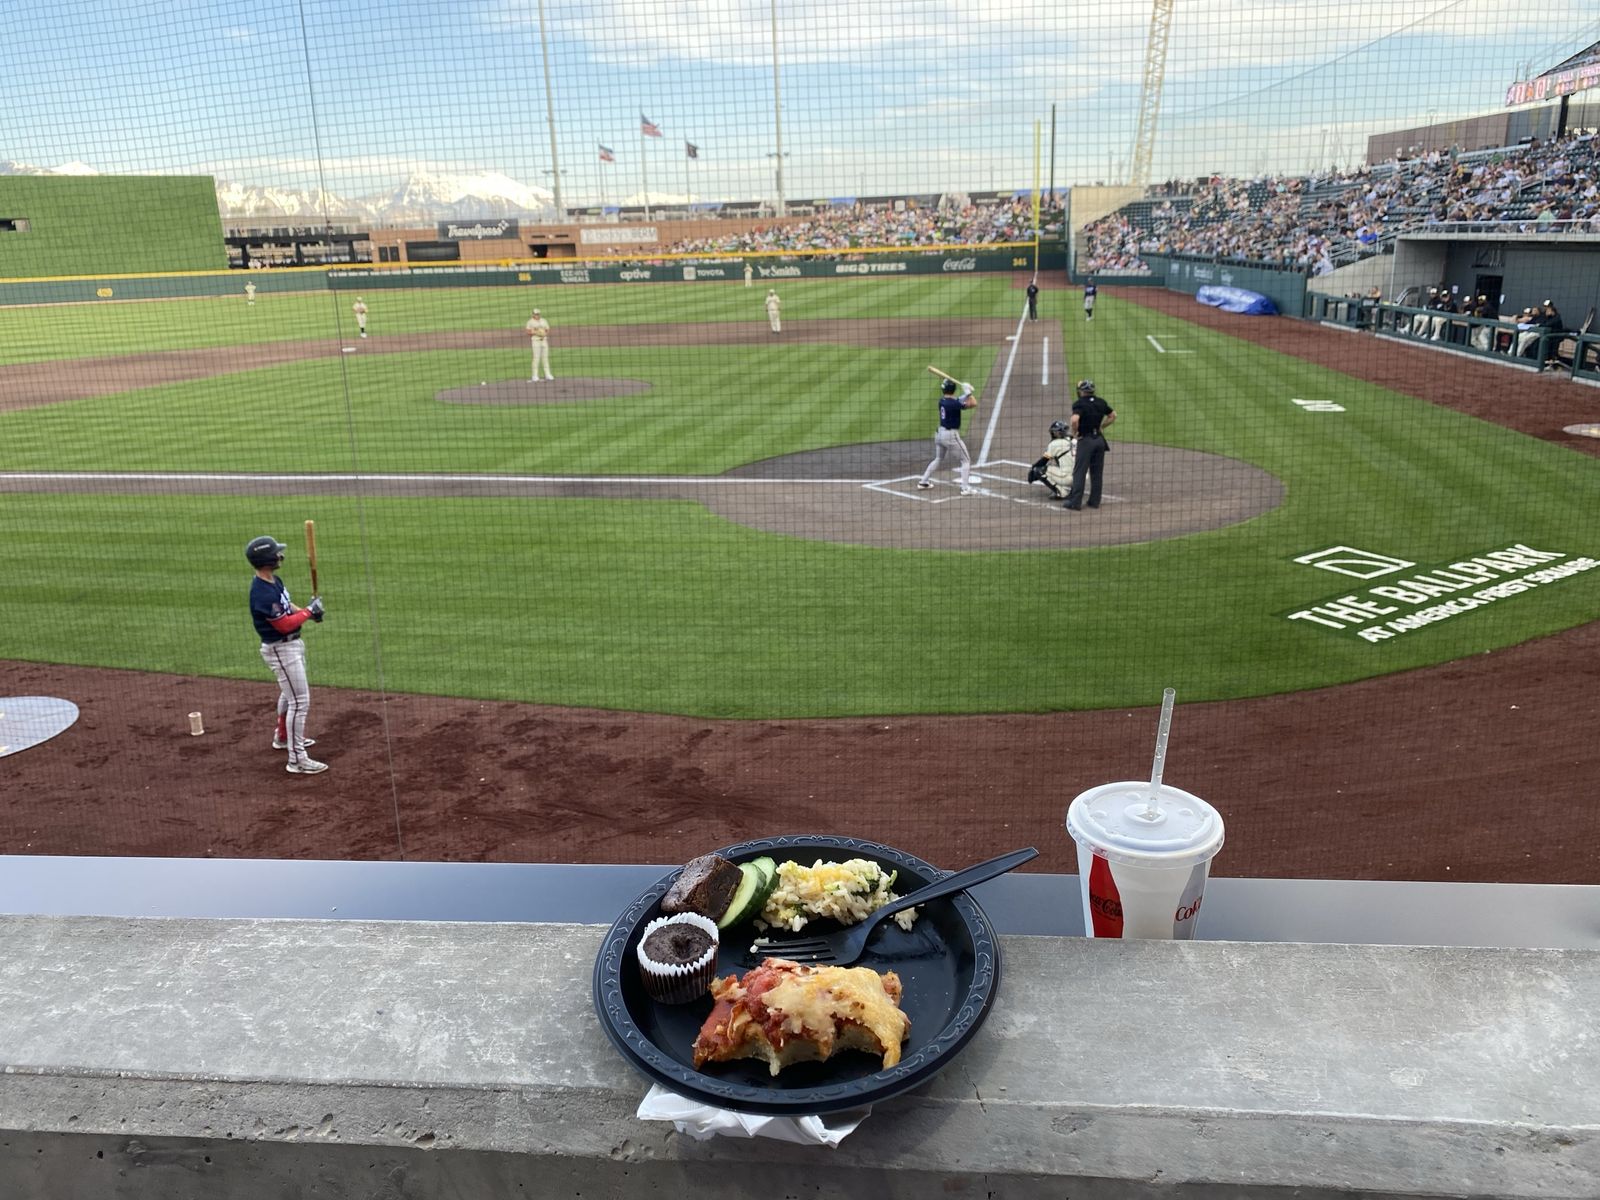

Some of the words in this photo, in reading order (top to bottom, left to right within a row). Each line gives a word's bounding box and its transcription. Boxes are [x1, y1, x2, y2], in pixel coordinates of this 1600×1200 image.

[697, 269, 725, 277] TOYOTA
[836, 264, 857, 273] BIG
[870, 263, 906, 272] TIRES
[1288, 595, 1399, 629] THE
[1369, 544, 1566, 604] BALLPARK
[1357, 626, 1396, 643] AT
[1385, 597, 1489, 633] AMERICA
[1473, 579, 1538, 602] FIRST
